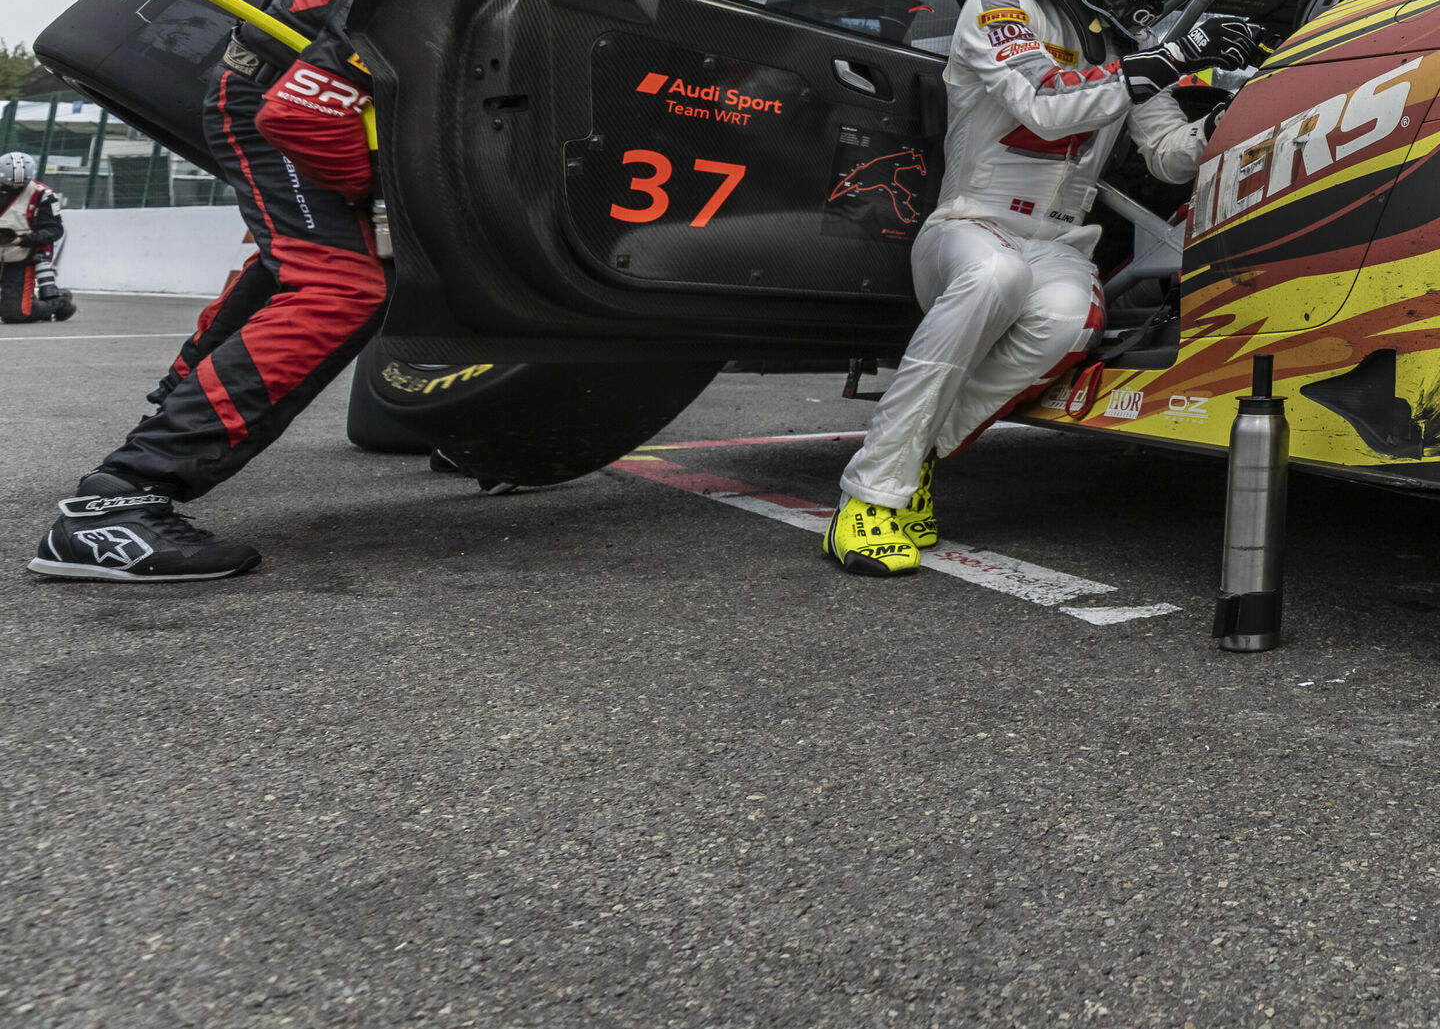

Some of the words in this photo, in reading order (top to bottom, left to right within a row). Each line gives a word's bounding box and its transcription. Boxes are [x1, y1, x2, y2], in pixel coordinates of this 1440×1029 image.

[981, 9, 1026, 24] PIRELLI
[1190, 29, 1208, 47] OMP
[995, 40, 1041, 62] Eibach
[667, 78, 720, 103] Audi
[724, 88, 783, 115] Sport
[665, 99, 710, 120] Team
[714, 109, 751, 127] WRT
[609, 148, 747, 228] 37
